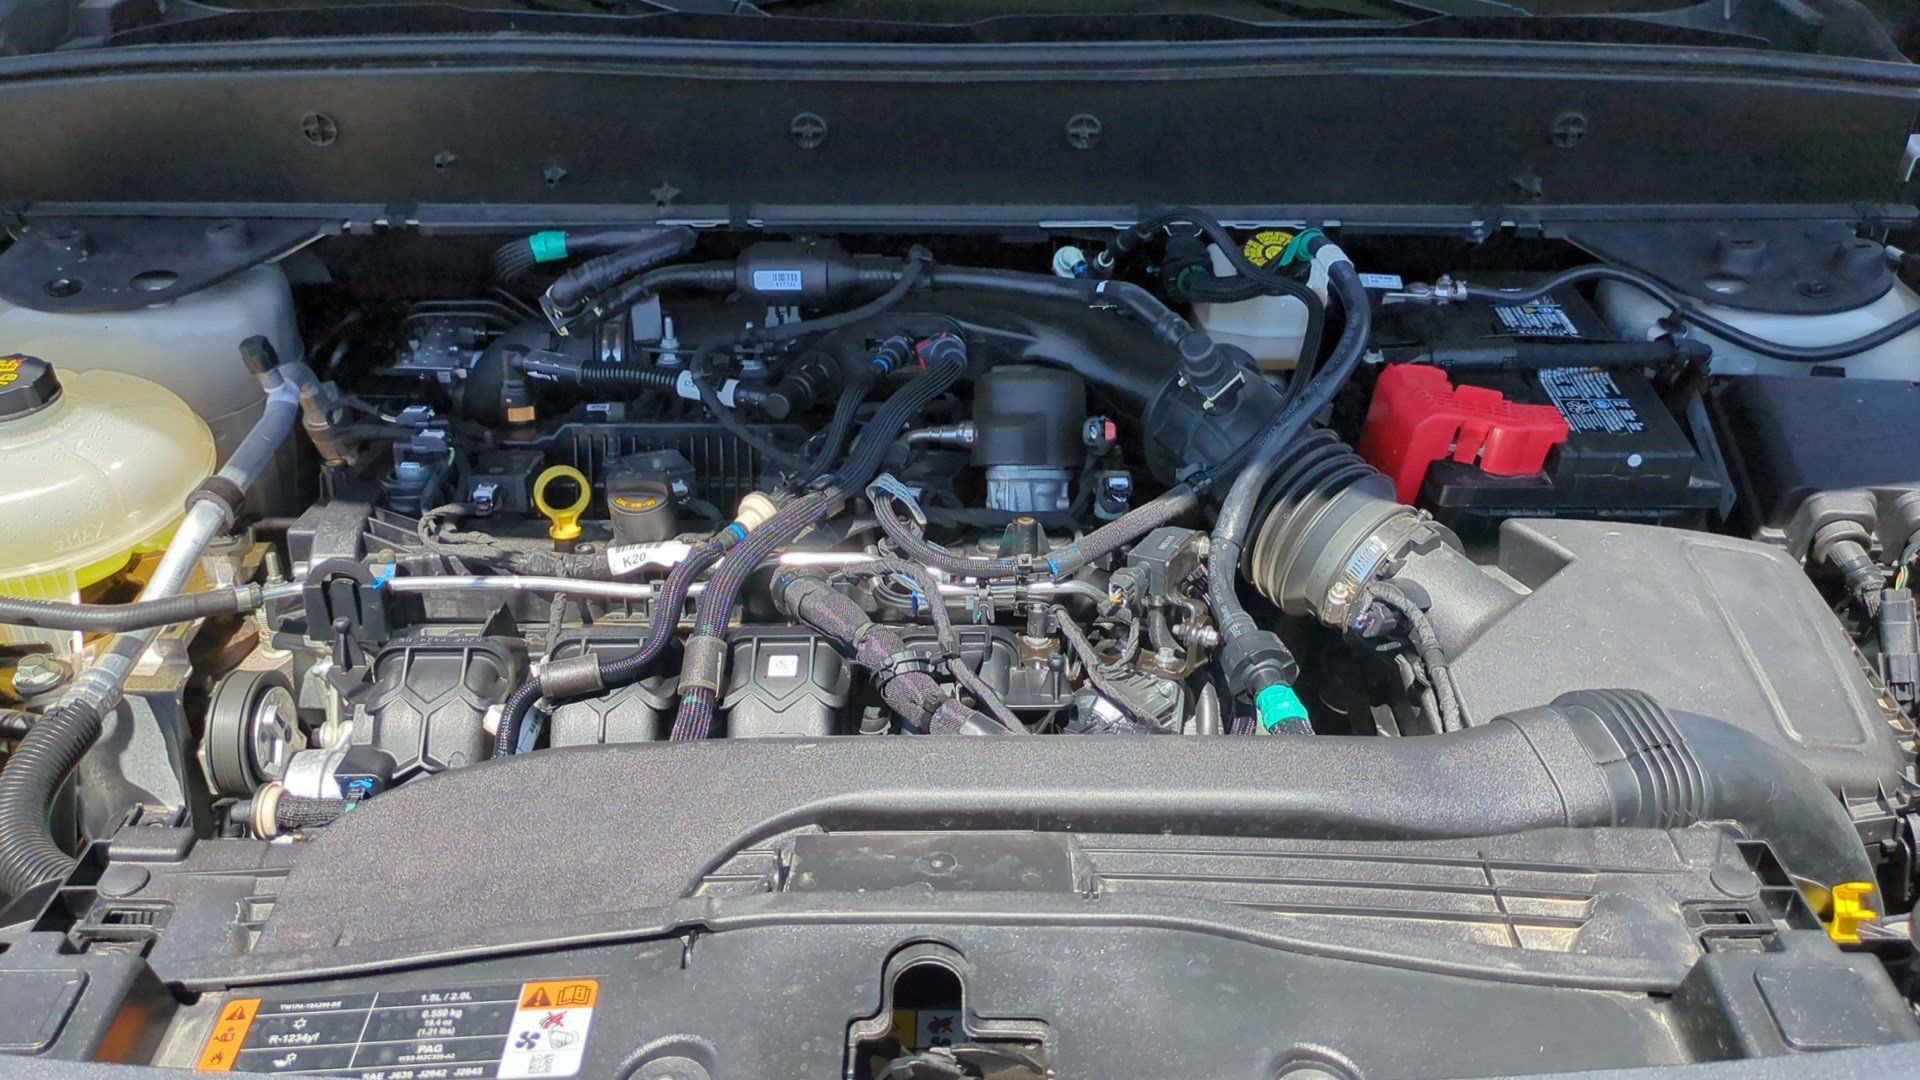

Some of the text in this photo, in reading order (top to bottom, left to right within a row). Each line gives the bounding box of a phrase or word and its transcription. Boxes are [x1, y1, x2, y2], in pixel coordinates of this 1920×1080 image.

[623, 552, 646, 567] K20
[450, 991, 472, 1001] 2.0L
[421, 1008, 463, 1020] 0.550 kg
[269, 1032, 320, 1045] R-1234yf
[417, 1043, 443, 1054] PAG
[362, 1071, 385, 1080] SAE
[388, 1070, 414, 1080] J639
